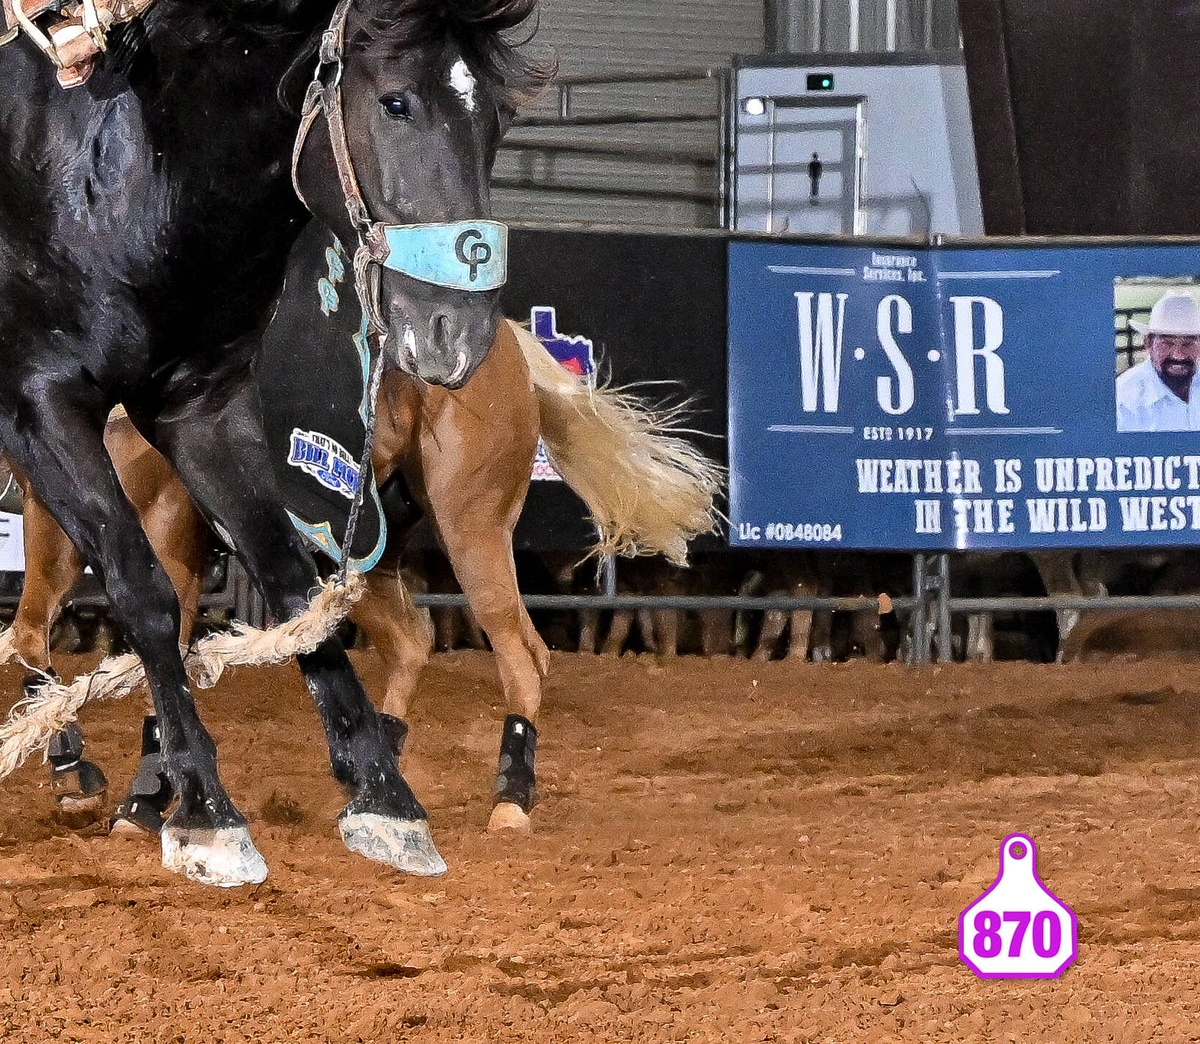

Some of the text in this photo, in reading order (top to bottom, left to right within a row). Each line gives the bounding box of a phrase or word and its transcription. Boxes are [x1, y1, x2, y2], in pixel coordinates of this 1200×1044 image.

[898, 427, 933, 441] 1917
[855, 455, 1200, 494] WEATHER IS UNPREDICT
[914, 496, 1200, 533] IN THE WILD WEST
